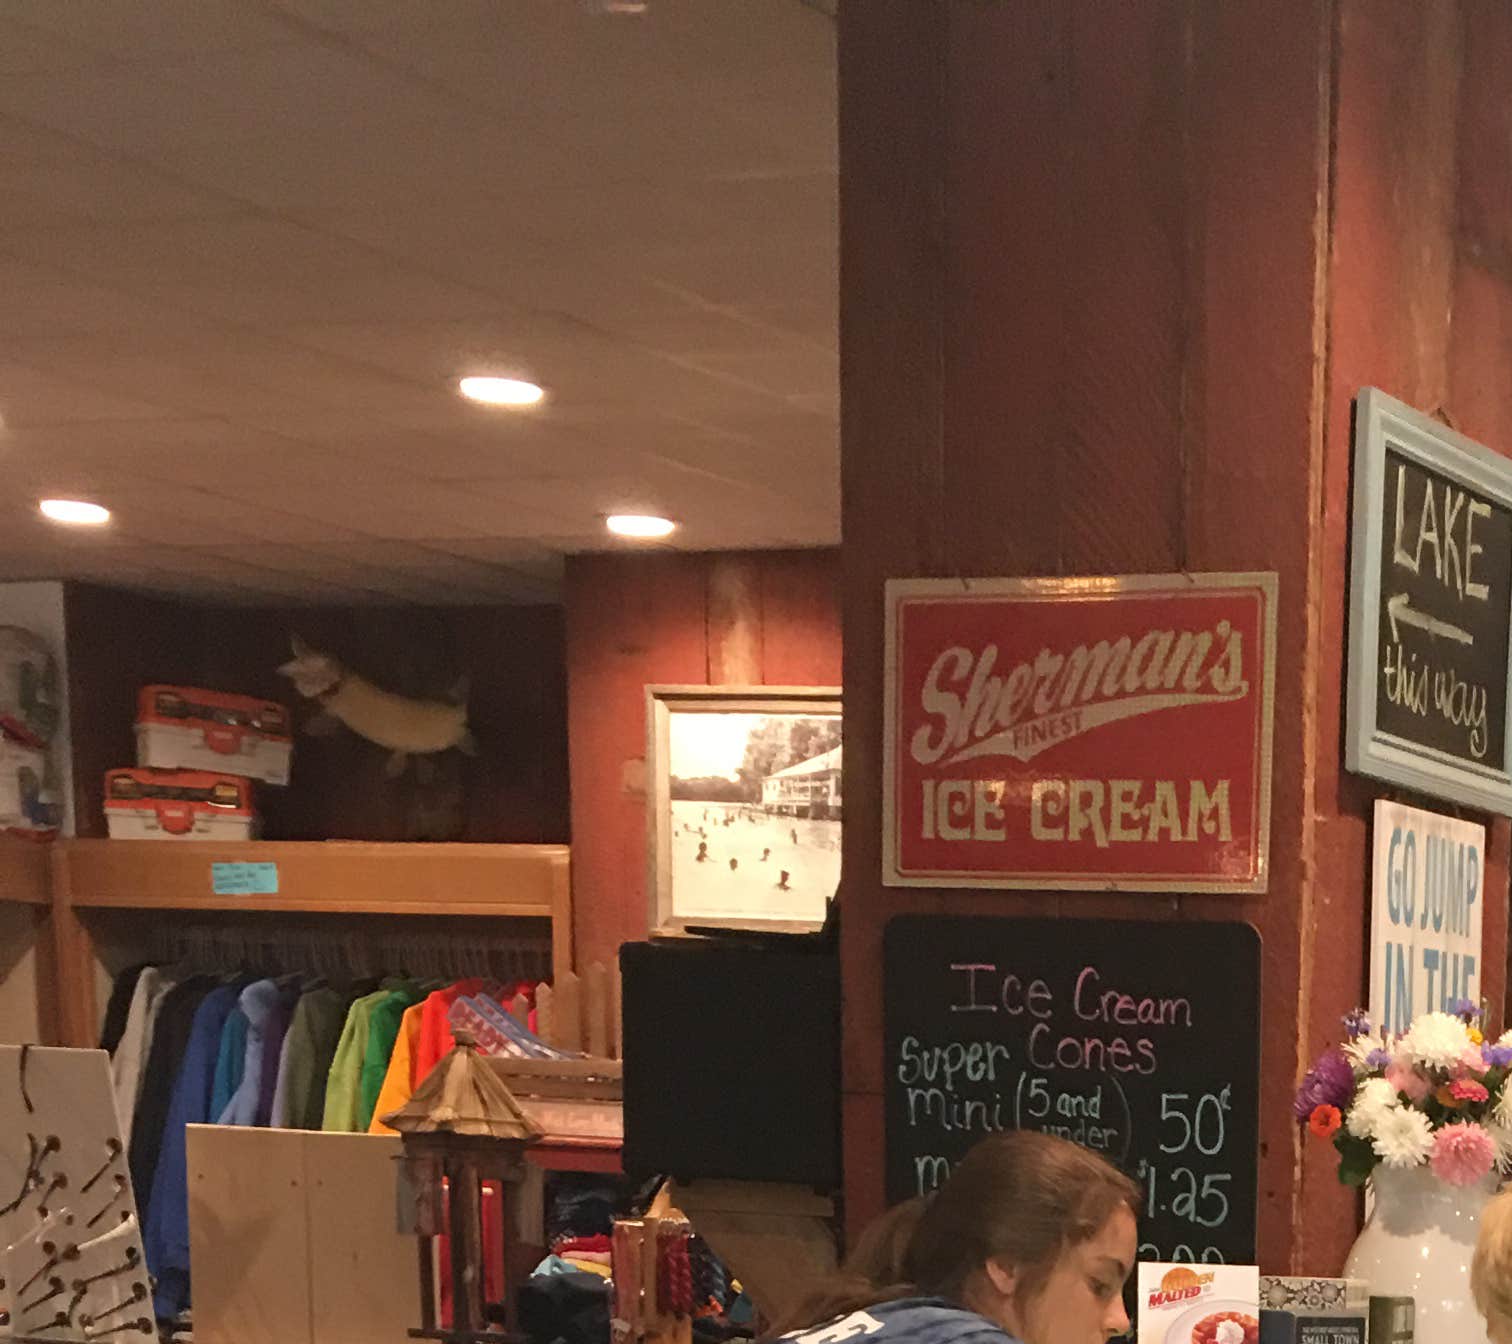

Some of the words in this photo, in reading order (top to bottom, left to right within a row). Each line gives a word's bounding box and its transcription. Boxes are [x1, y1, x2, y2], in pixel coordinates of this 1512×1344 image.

[1394, 464, 1492, 601] LAKE
[911, 619, 1250, 766] Sherman's
[1384, 644, 1429, 717] this
[1435, 669, 1488, 758] way
[1012, 709, 1084, 752] FINEST
[920, 778, 1007, 842] ICE
[1030, 778, 1233, 849] CREAM
[1386, 826, 1416, 927] GO
[1420, 833, 1479, 939] JUMP
[950, 963, 1053, 1019] Ice
[1073, 966, 1193, 1027] Cream
[1384, 941, 1414, 1035] IN
[898, 1036, 1010, 1091] Super
[1028, 1022, 1156, 1075] Cones
[906, 1086, 1004, 1131] mini
[1056, 1085, 1102, 1119] and
[1148, 1285, 1201, 1308] MALTED
